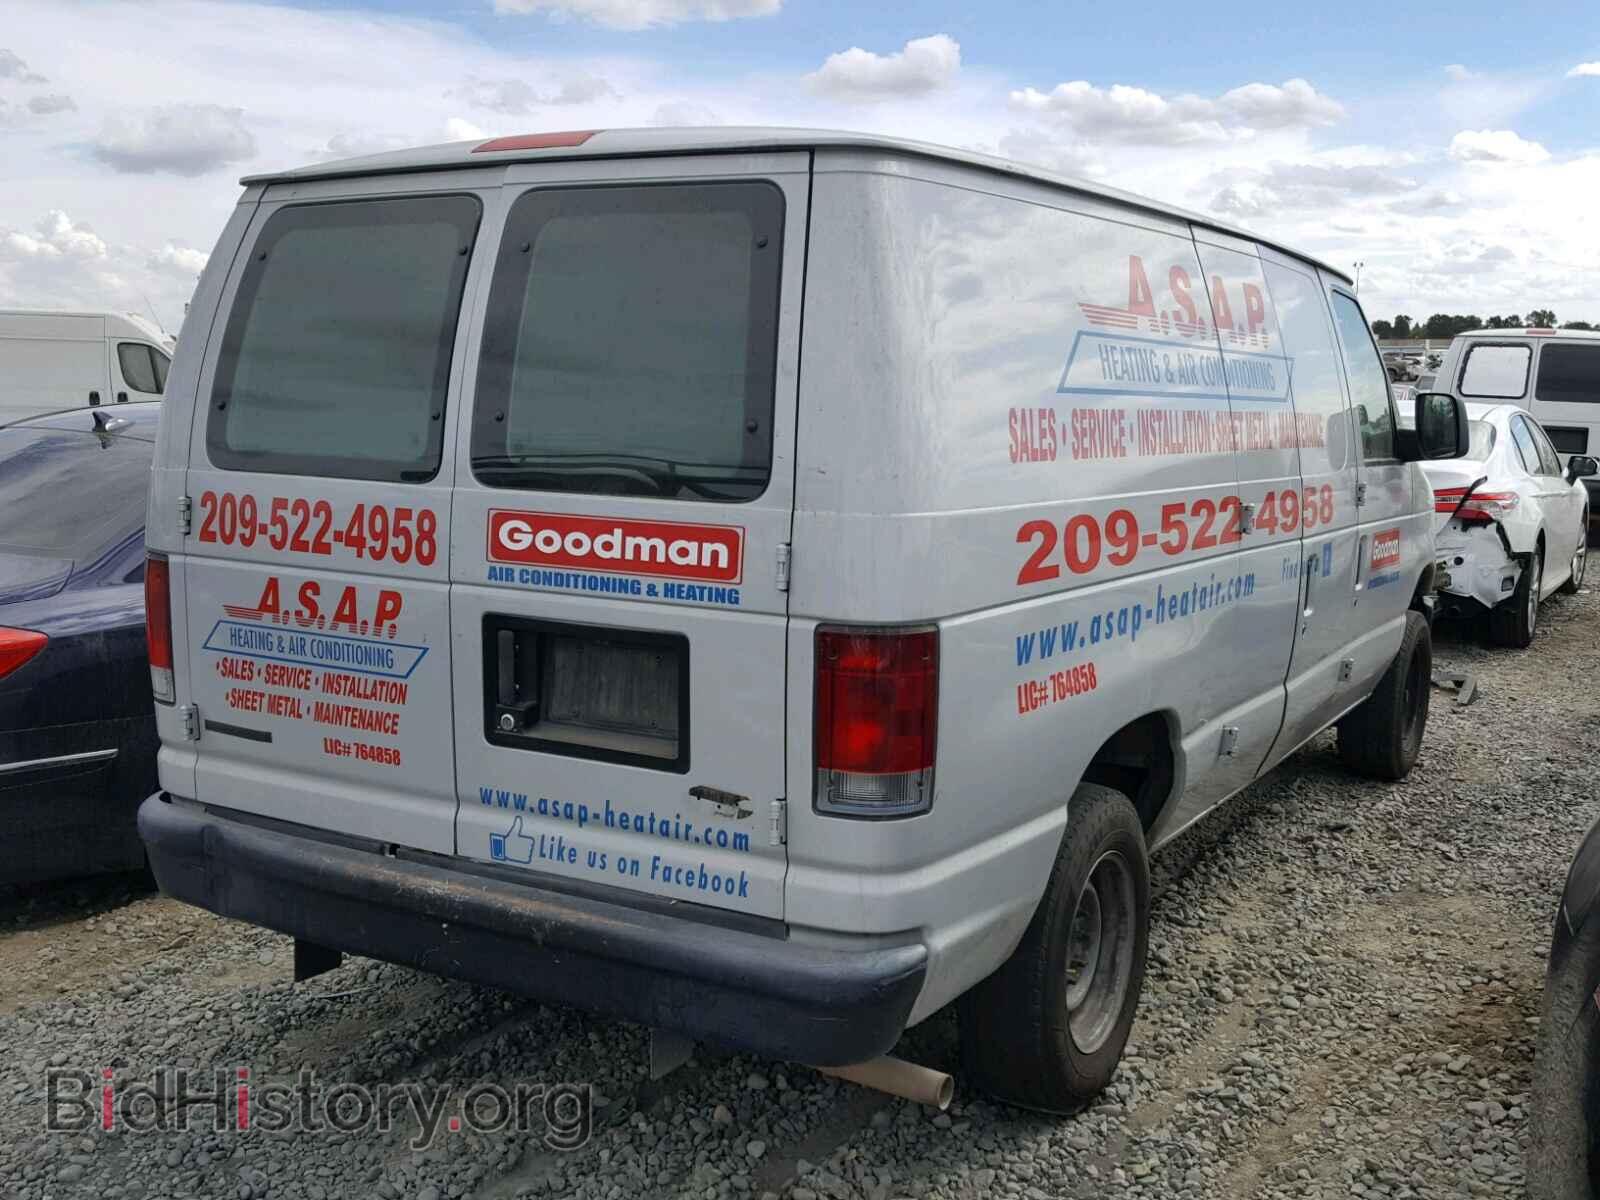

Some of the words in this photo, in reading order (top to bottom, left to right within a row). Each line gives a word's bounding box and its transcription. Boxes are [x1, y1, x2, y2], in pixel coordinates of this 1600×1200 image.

[1128, 254, 1270, 349] A.S.A.P.
[1098, 343, 1161, 384] HEATING
[1164, 354, 1175, 384] &
[1177, 351, 1199, 385] AIR
[1008, 407, 1057, 464] SALES
[1071, 407, 1128, 461] SERVICE
[1136, 409, 1210, 457] INSTALLATION
[198, 490, 437, 567] 209-522-4958
[498, 519, 729, 569] Goodman
[1016, 483, 1334, 586] 209-5224958
[257, 576, 403, 640] A.S.A.P.
[488, 565, 515, 583] AIR
[519, 568, 642, 595] CONDITIONING
[646, 583, 659, 598] &
[663, 582, 740, 605] HEATING
[1016, 570, 1256, 666] www.asap-heatair.com
[229, 626, 274, 651] HEATING
[277, 635, 286, 653] &
[288, 636, 307, 657] AIR
[310, 638, 394, 669] CONDITIONING
[220, 656, 254, 682] SALES
[264, 663, 312, 690] SERVICE
[322, 671, 408, 705] INSTALLATION
[1049, 662, 1097, 703] 764858
[230, 687, 265, 713] SHEET
[267, 693, 303, 719] METAL
[313, 700, 400, 735] MAINTENANCE
[479, 786, 750, 852] www.asap-heatair.com
[539, 834, 577, 864] Like
[587, 850, 608, 871] us
[617, 856, 640, 877] on
[650, 855, 749, 898] Facebook
